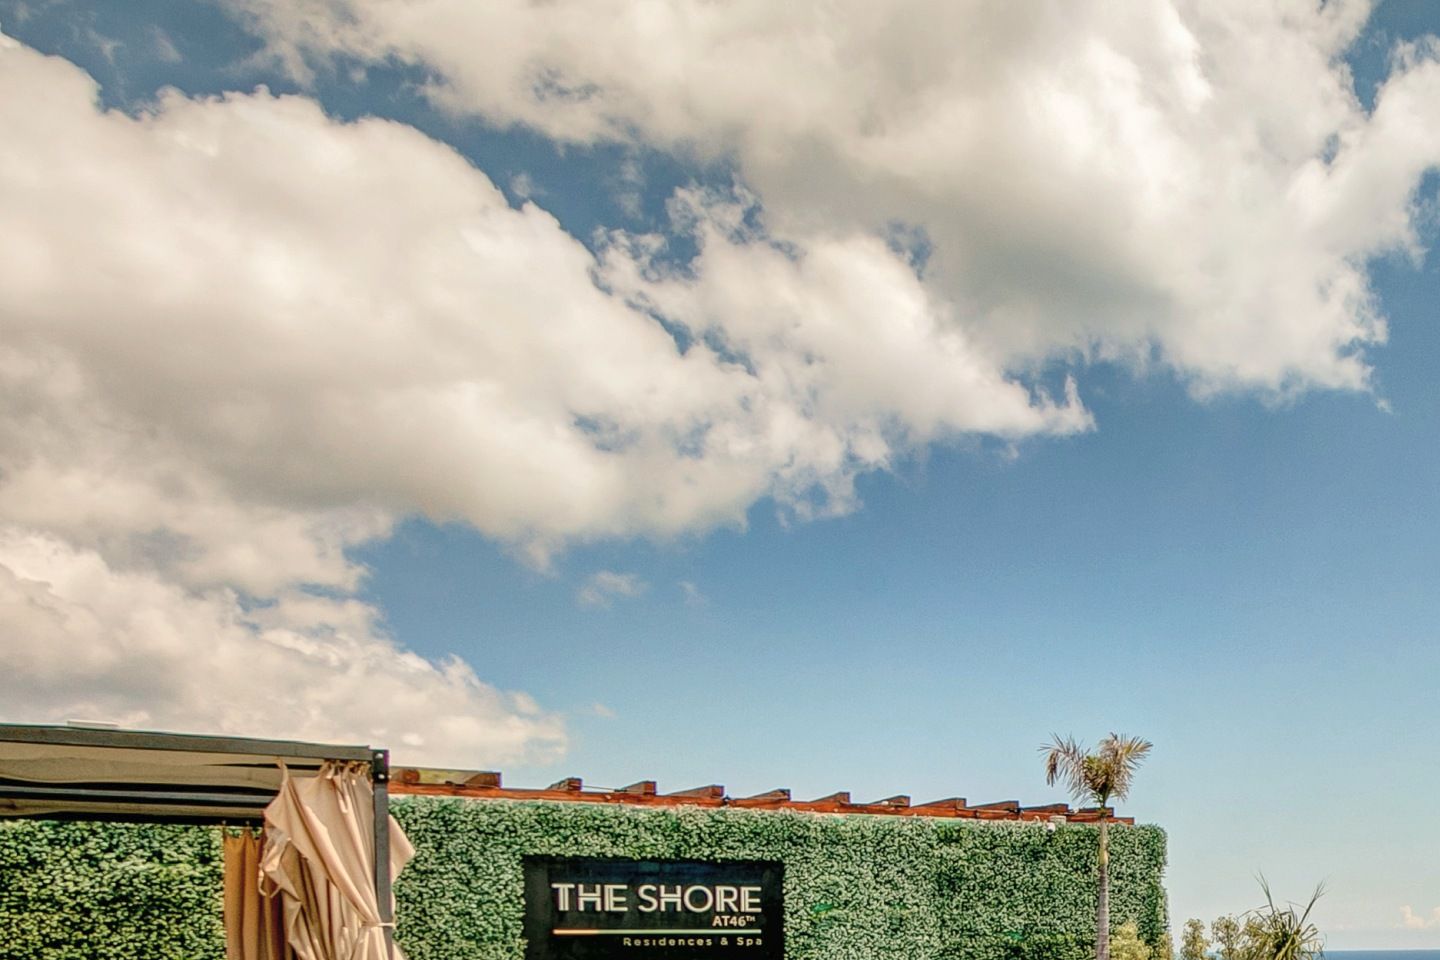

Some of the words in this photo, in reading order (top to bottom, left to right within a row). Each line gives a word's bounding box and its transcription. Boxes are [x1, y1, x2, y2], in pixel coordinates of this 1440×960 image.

[551, 883, 628, 912] THE
[637, 884, 762, 913] SHORE
[623, 937, 712, 946] Residences
[720, 937, 728, 946] &
[737, 937, 762, 947] Spa
